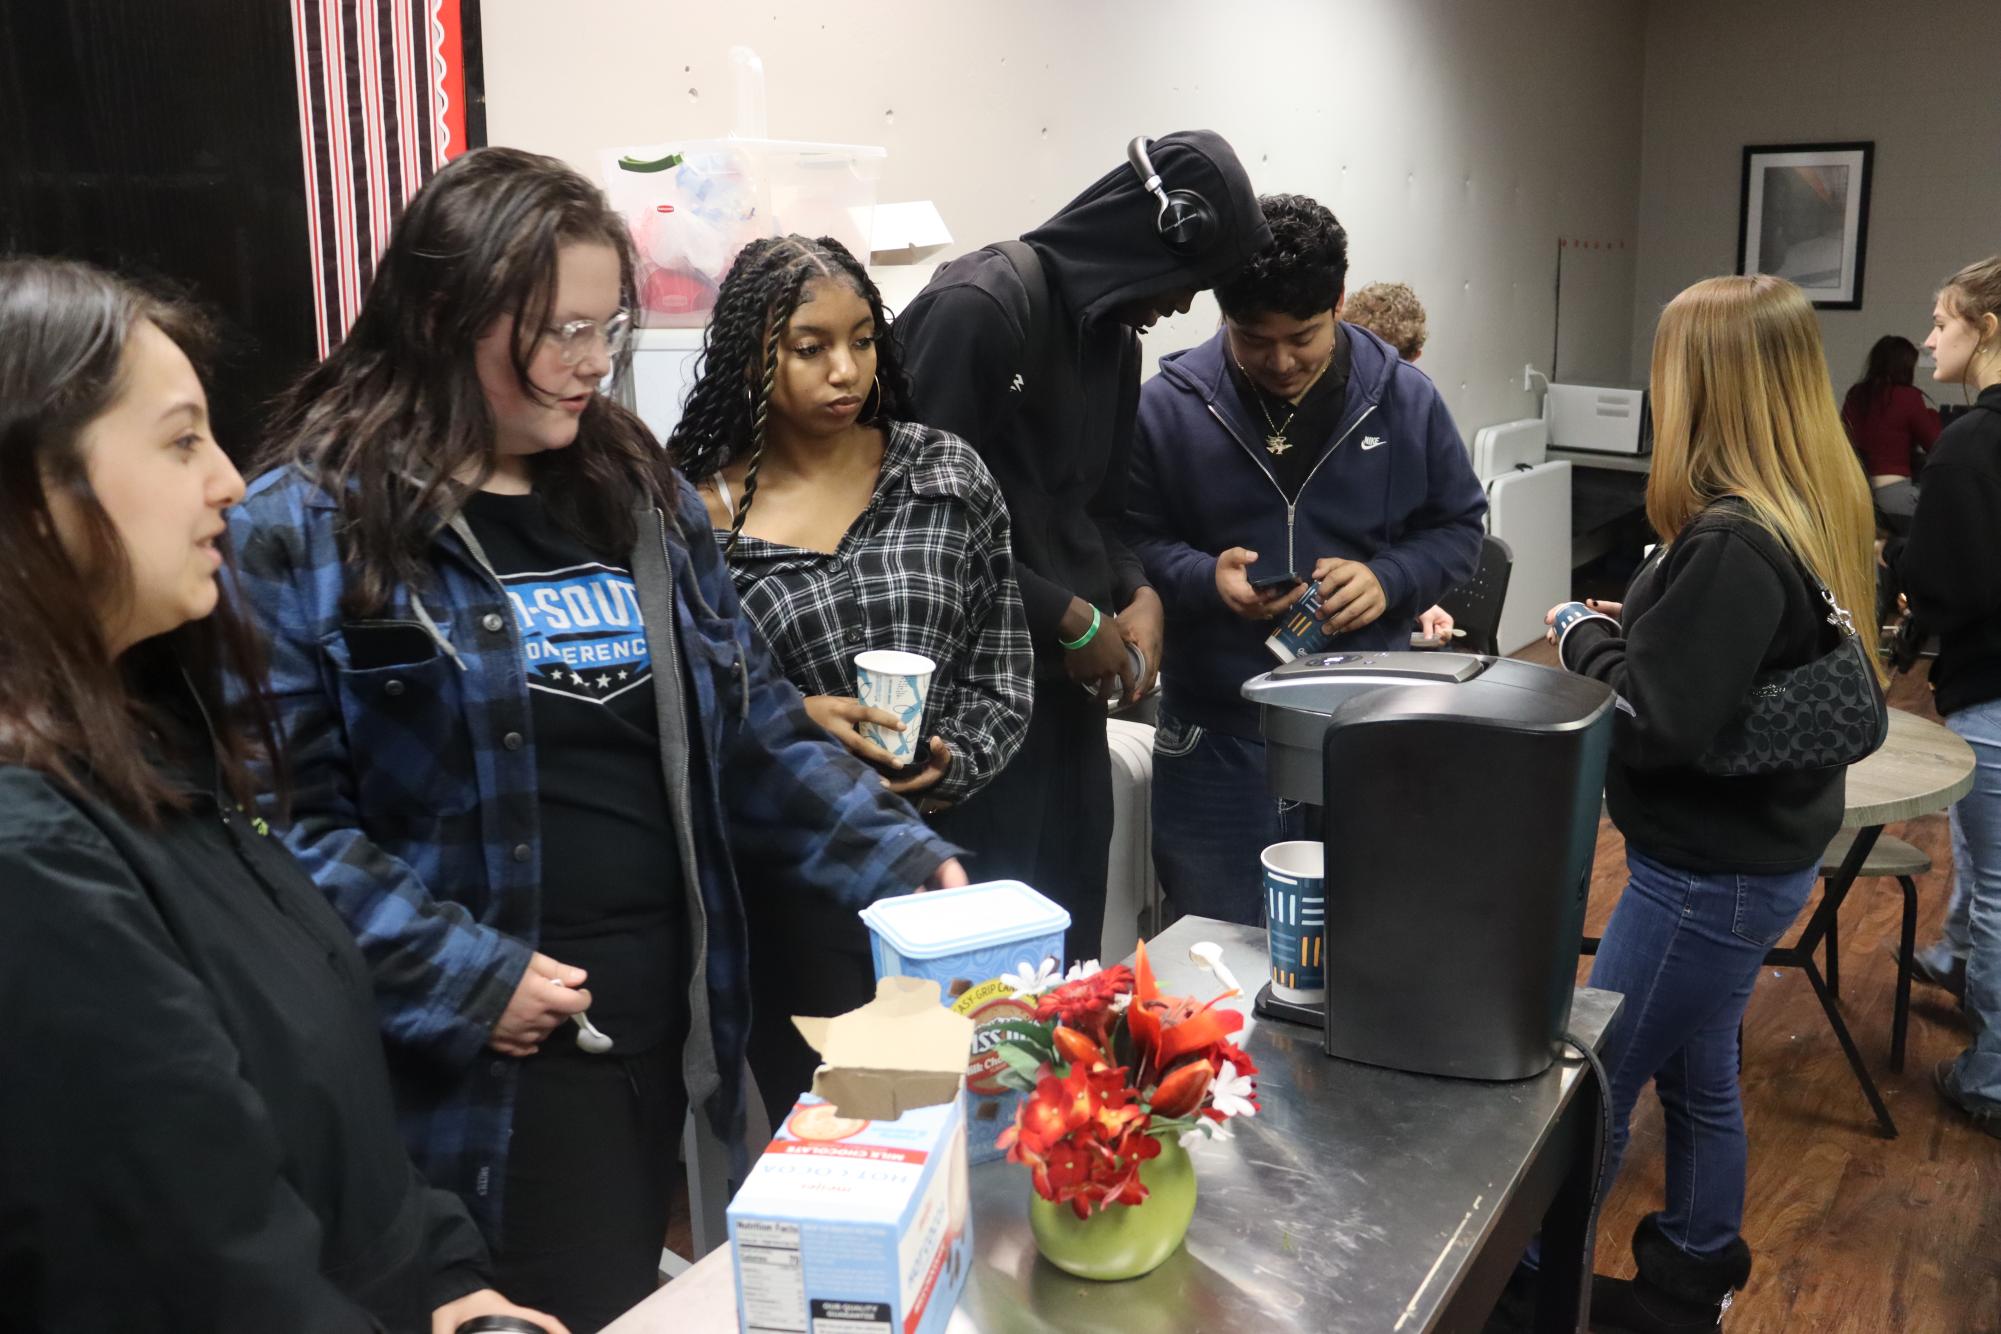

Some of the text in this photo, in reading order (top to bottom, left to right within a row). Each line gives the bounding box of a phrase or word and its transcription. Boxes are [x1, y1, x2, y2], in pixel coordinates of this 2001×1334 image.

[954, 984, 996, 1013] ASY-GRIP
[785, 1145, 869, 1159] CHOCOLATE
[870, 1150, 906, 1162] MILK
[737, 1221, 772, 1231] Nutrition
